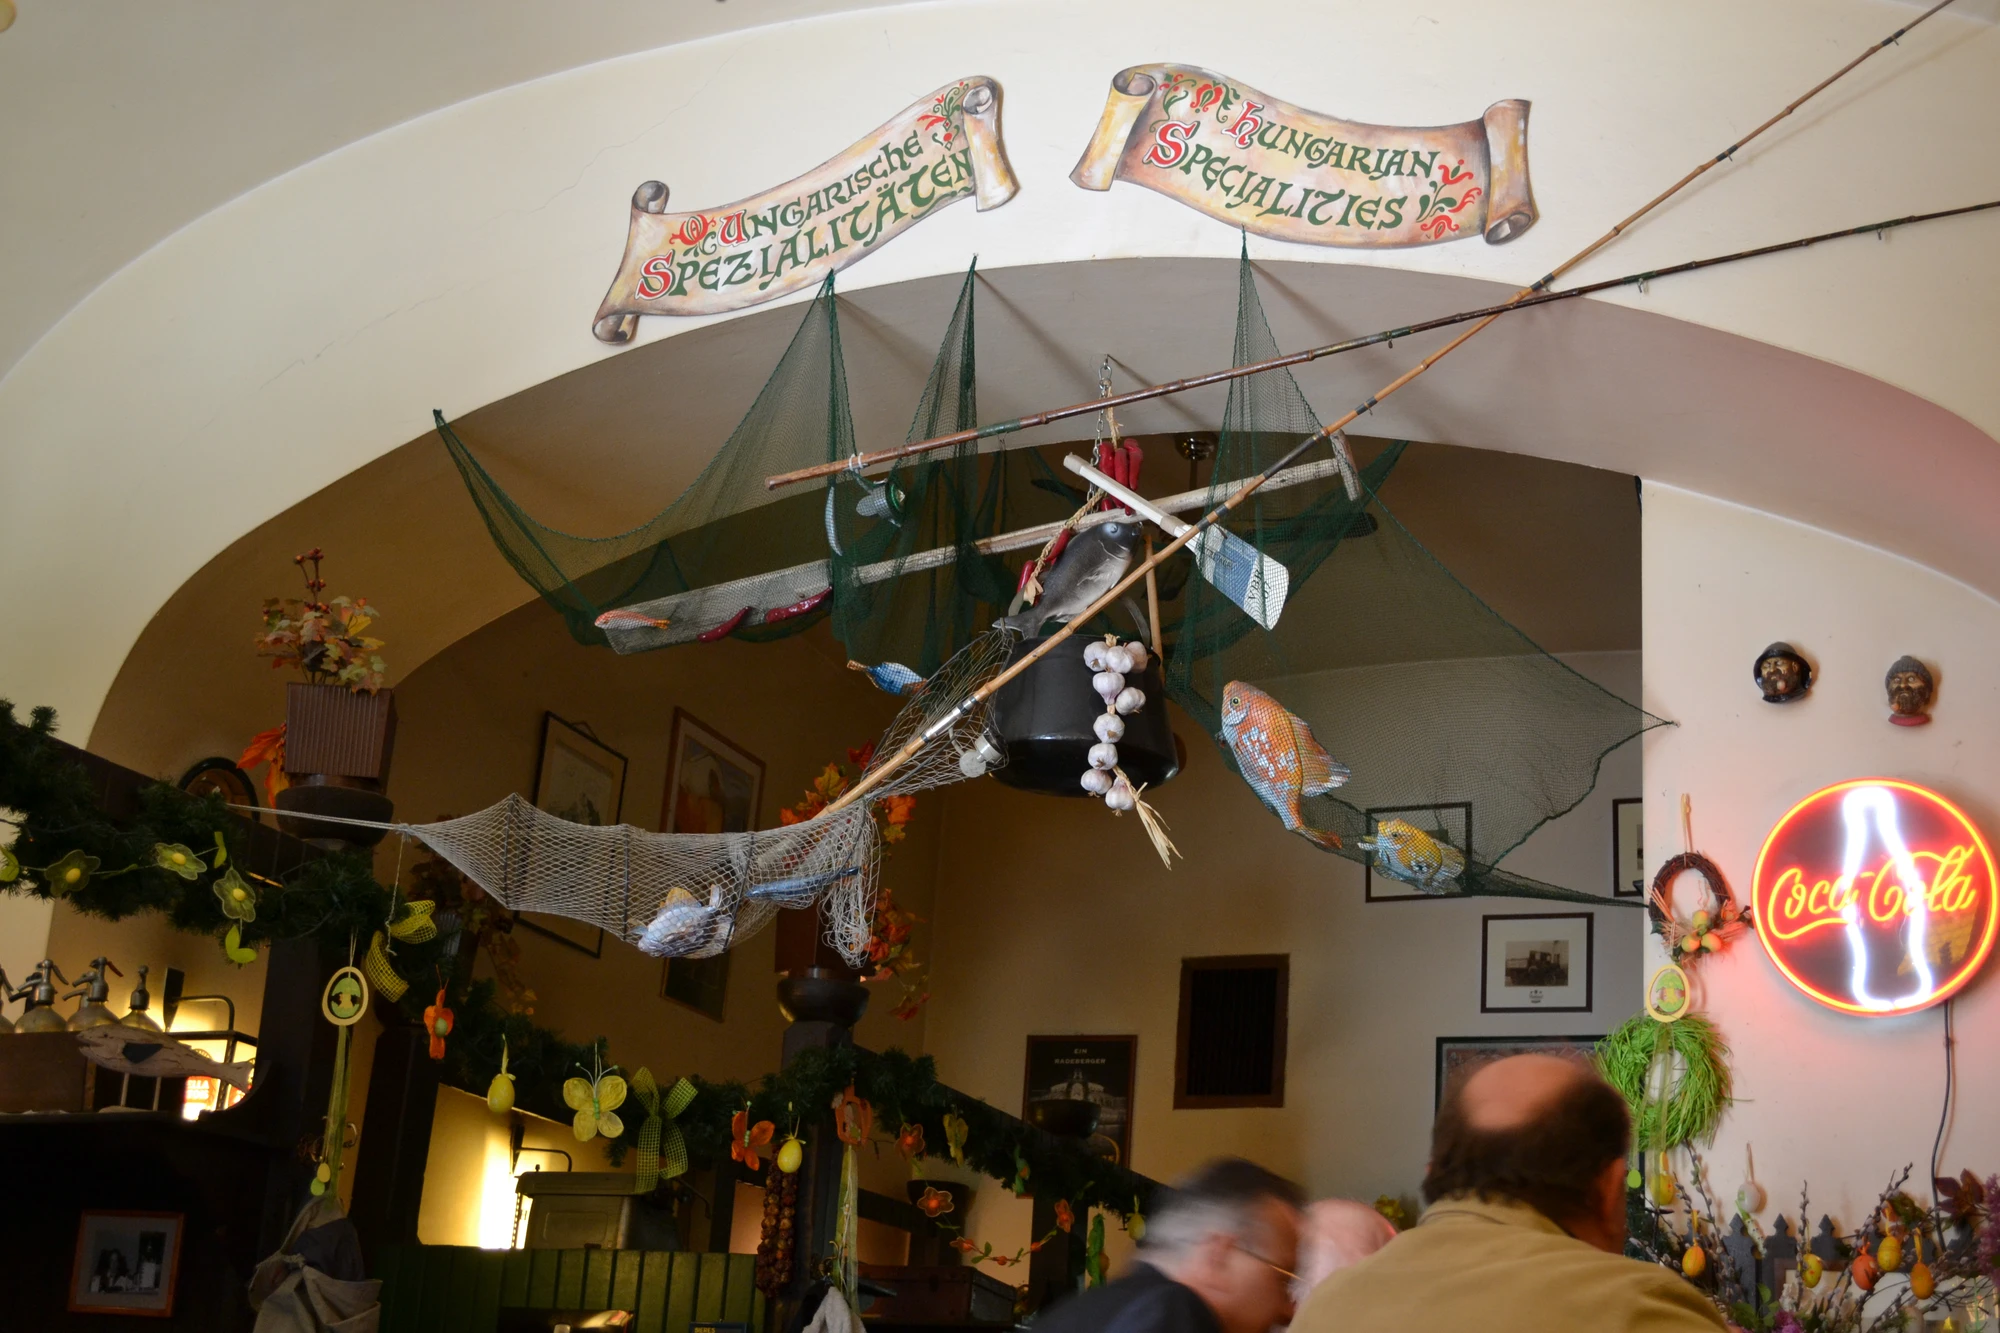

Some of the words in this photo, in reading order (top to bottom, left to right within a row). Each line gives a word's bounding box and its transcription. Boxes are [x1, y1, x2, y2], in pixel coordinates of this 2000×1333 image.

[636, 147, 973, 300] SPEZIALITÄTEN
[1142, 120, 1408, 230] SPECIALITIES
[1768, 844, 1977, 939] Coca-Cola
